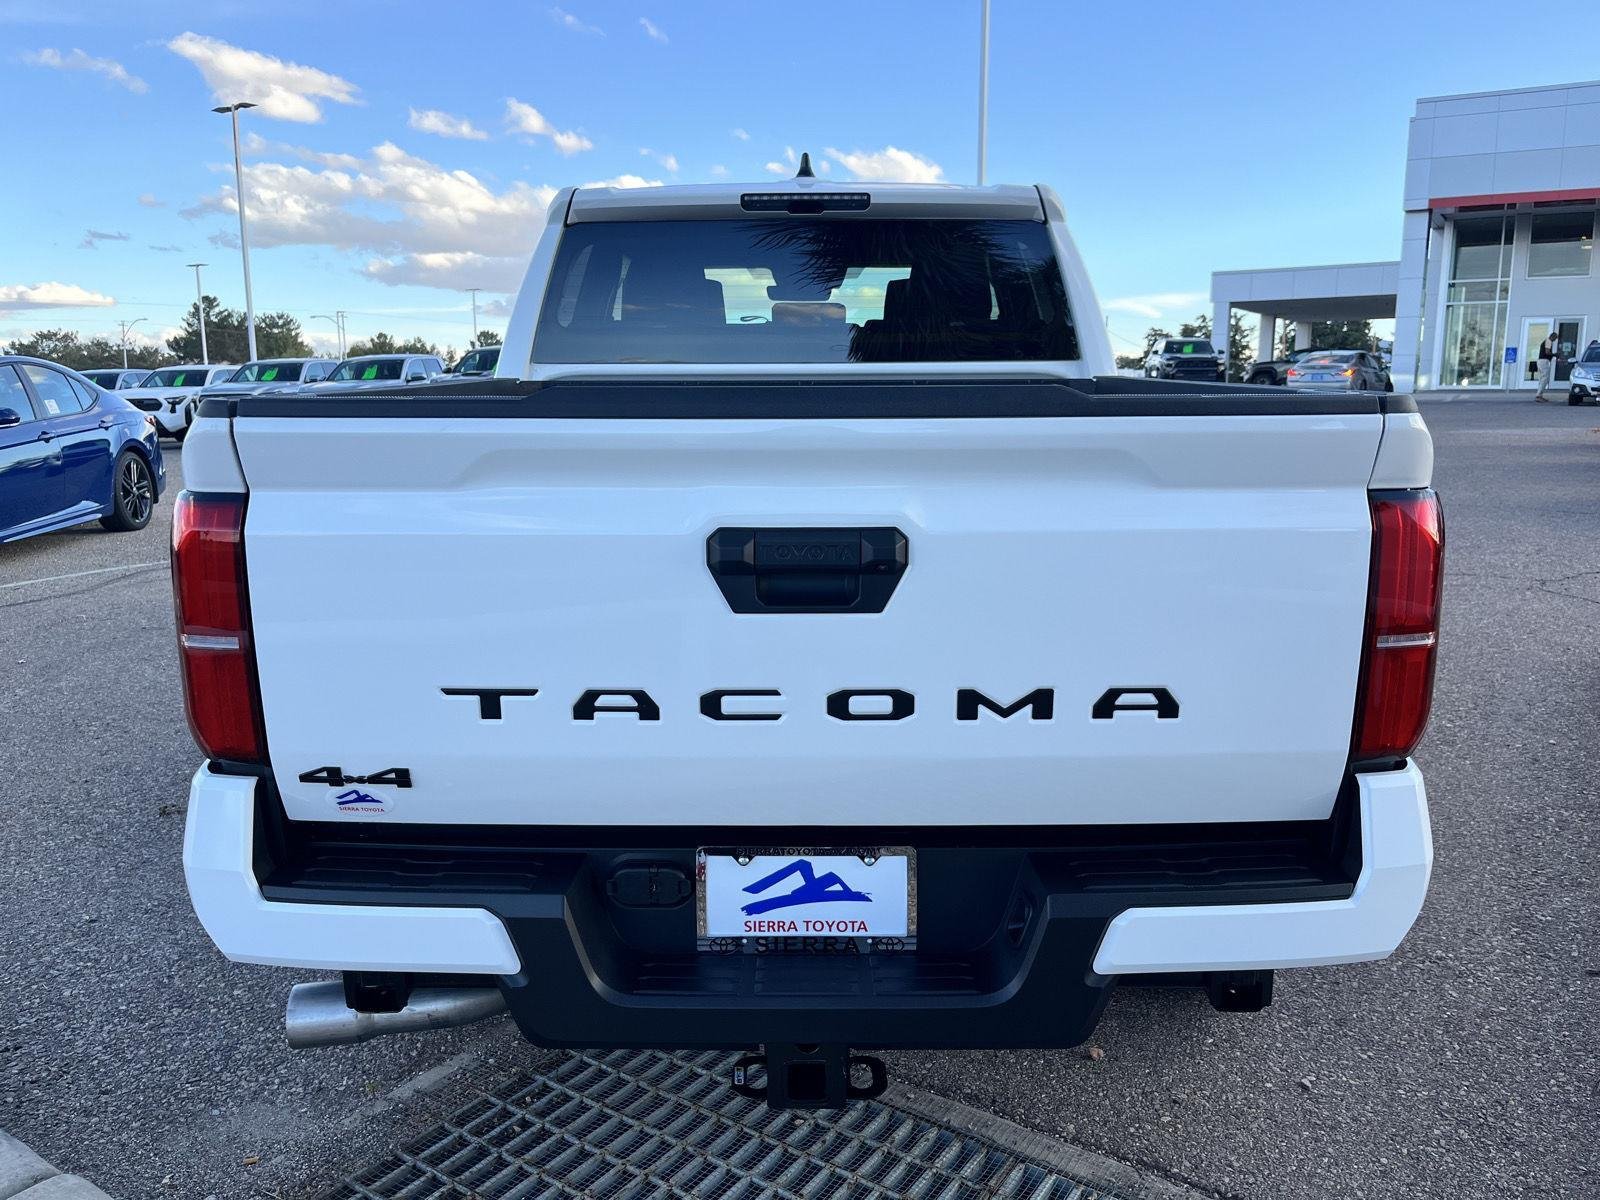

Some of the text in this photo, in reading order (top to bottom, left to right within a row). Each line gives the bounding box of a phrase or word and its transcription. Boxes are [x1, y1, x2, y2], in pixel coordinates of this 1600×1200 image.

[759, 543, 855, 561] TOYOTA
[440, 687, 1180, 721] TACOMA
[744, 920, 868, 933] SIERRA TOYOTA
[755, 936, 862, 954] SIERRA
